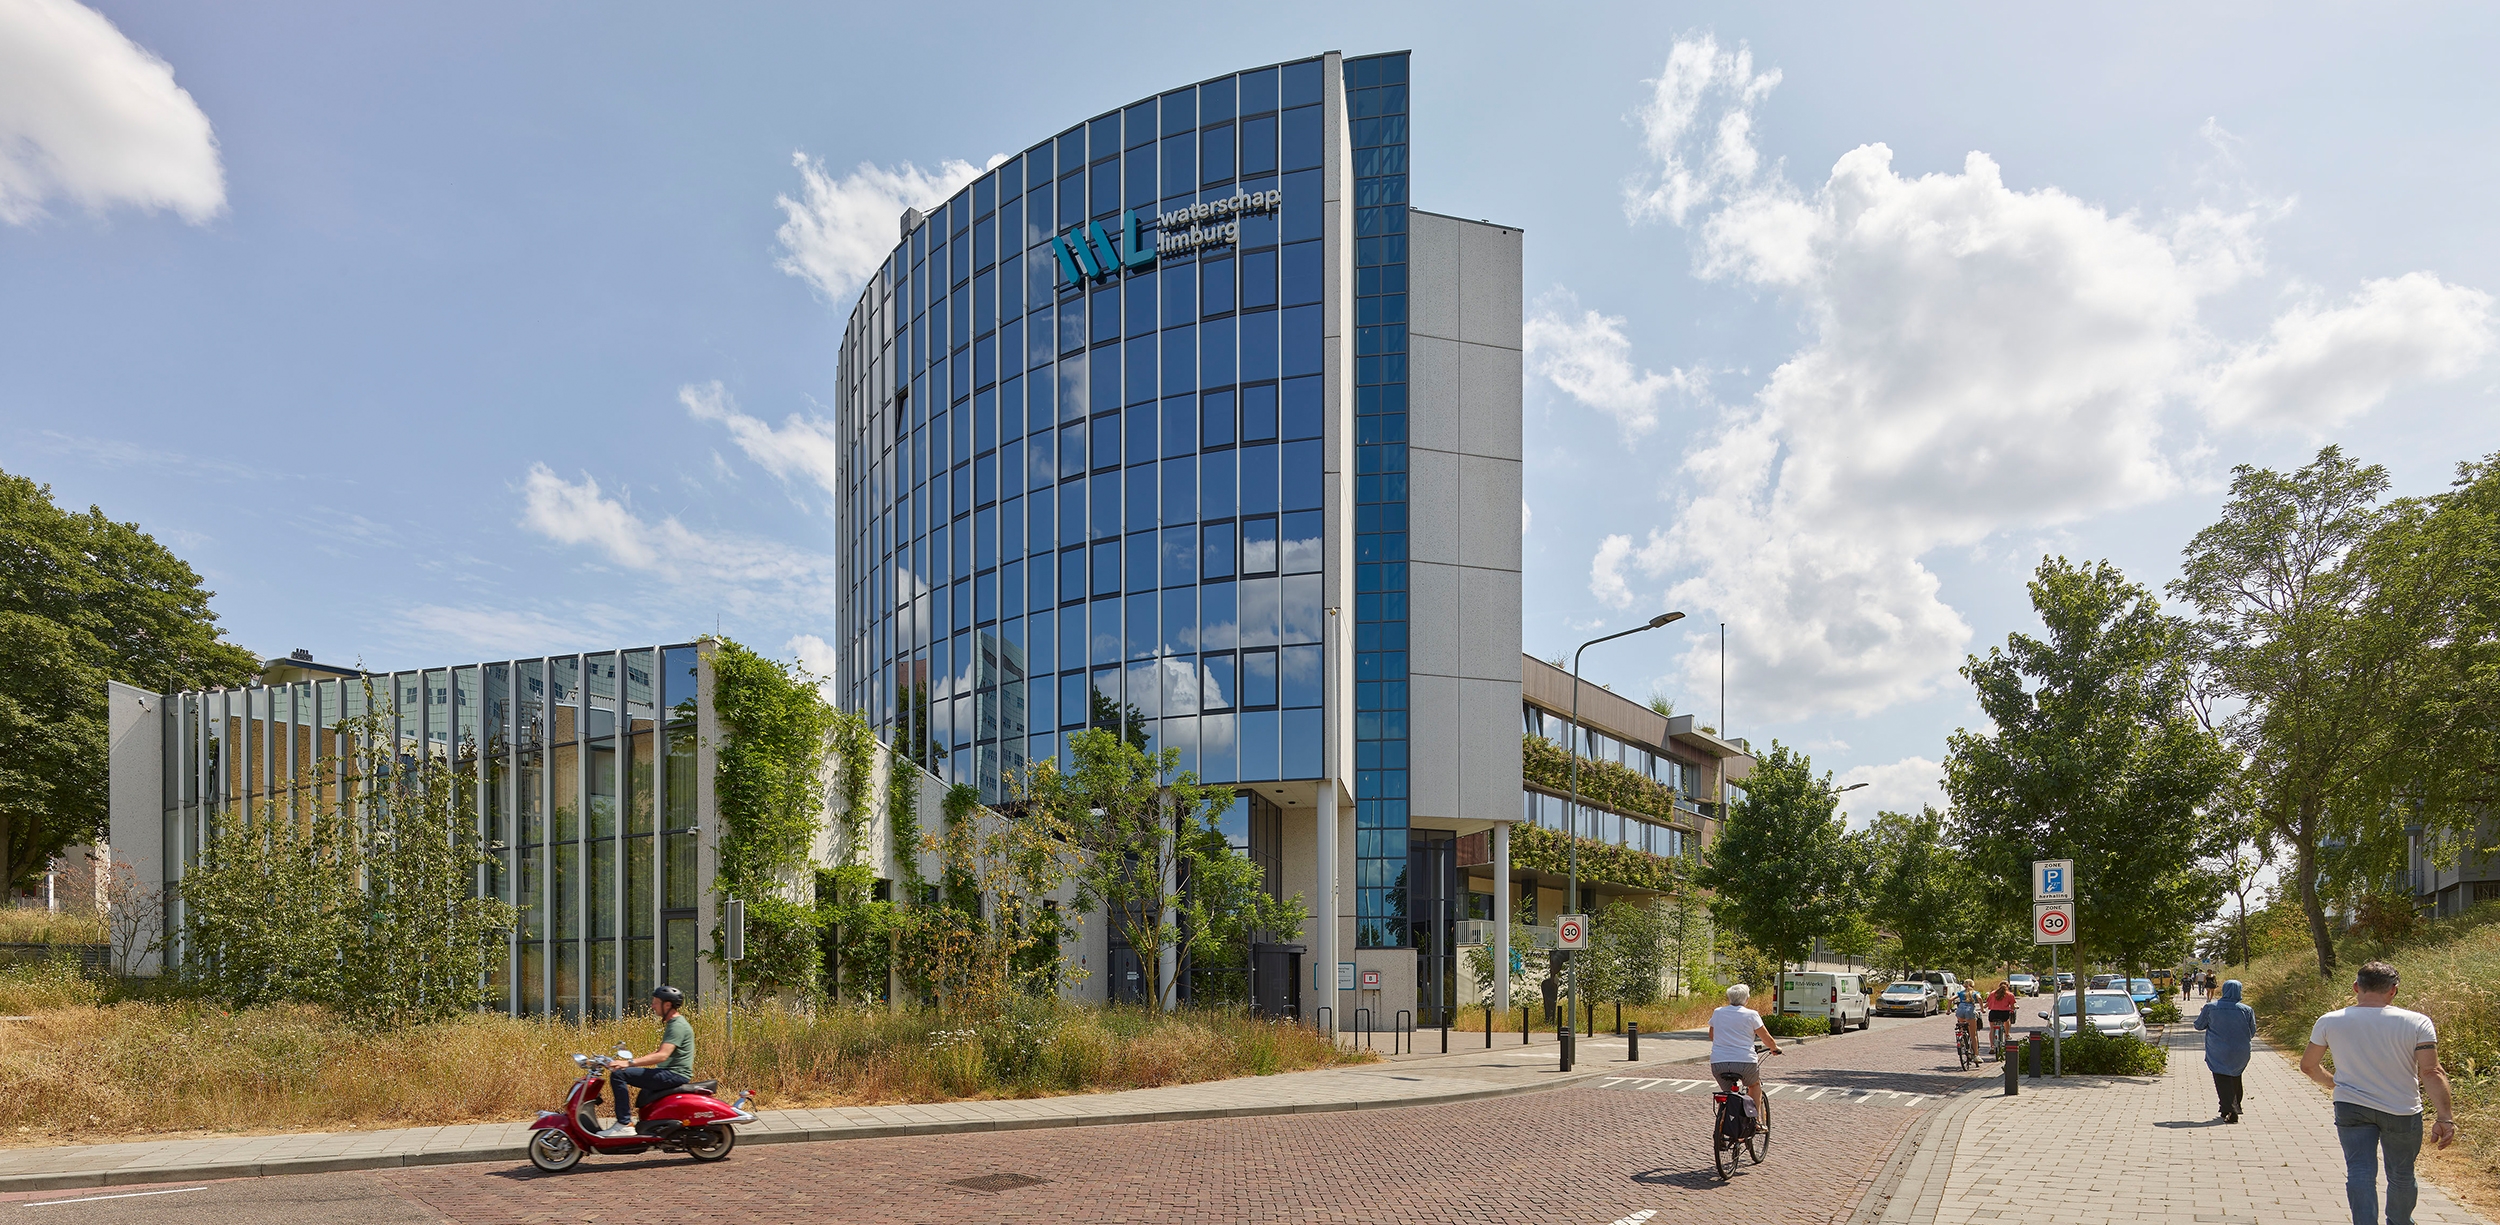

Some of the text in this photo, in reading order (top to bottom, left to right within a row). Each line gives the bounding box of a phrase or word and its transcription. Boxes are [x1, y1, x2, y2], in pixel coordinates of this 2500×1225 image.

[1159, 188, 1280, 228] waterschap
[1159, 222, 1240, 252] limburg
[2048, 871, 2058, 883] P
[2045, 919, 2063, 928] 30
[1565, 928, 1577, 936] 30
